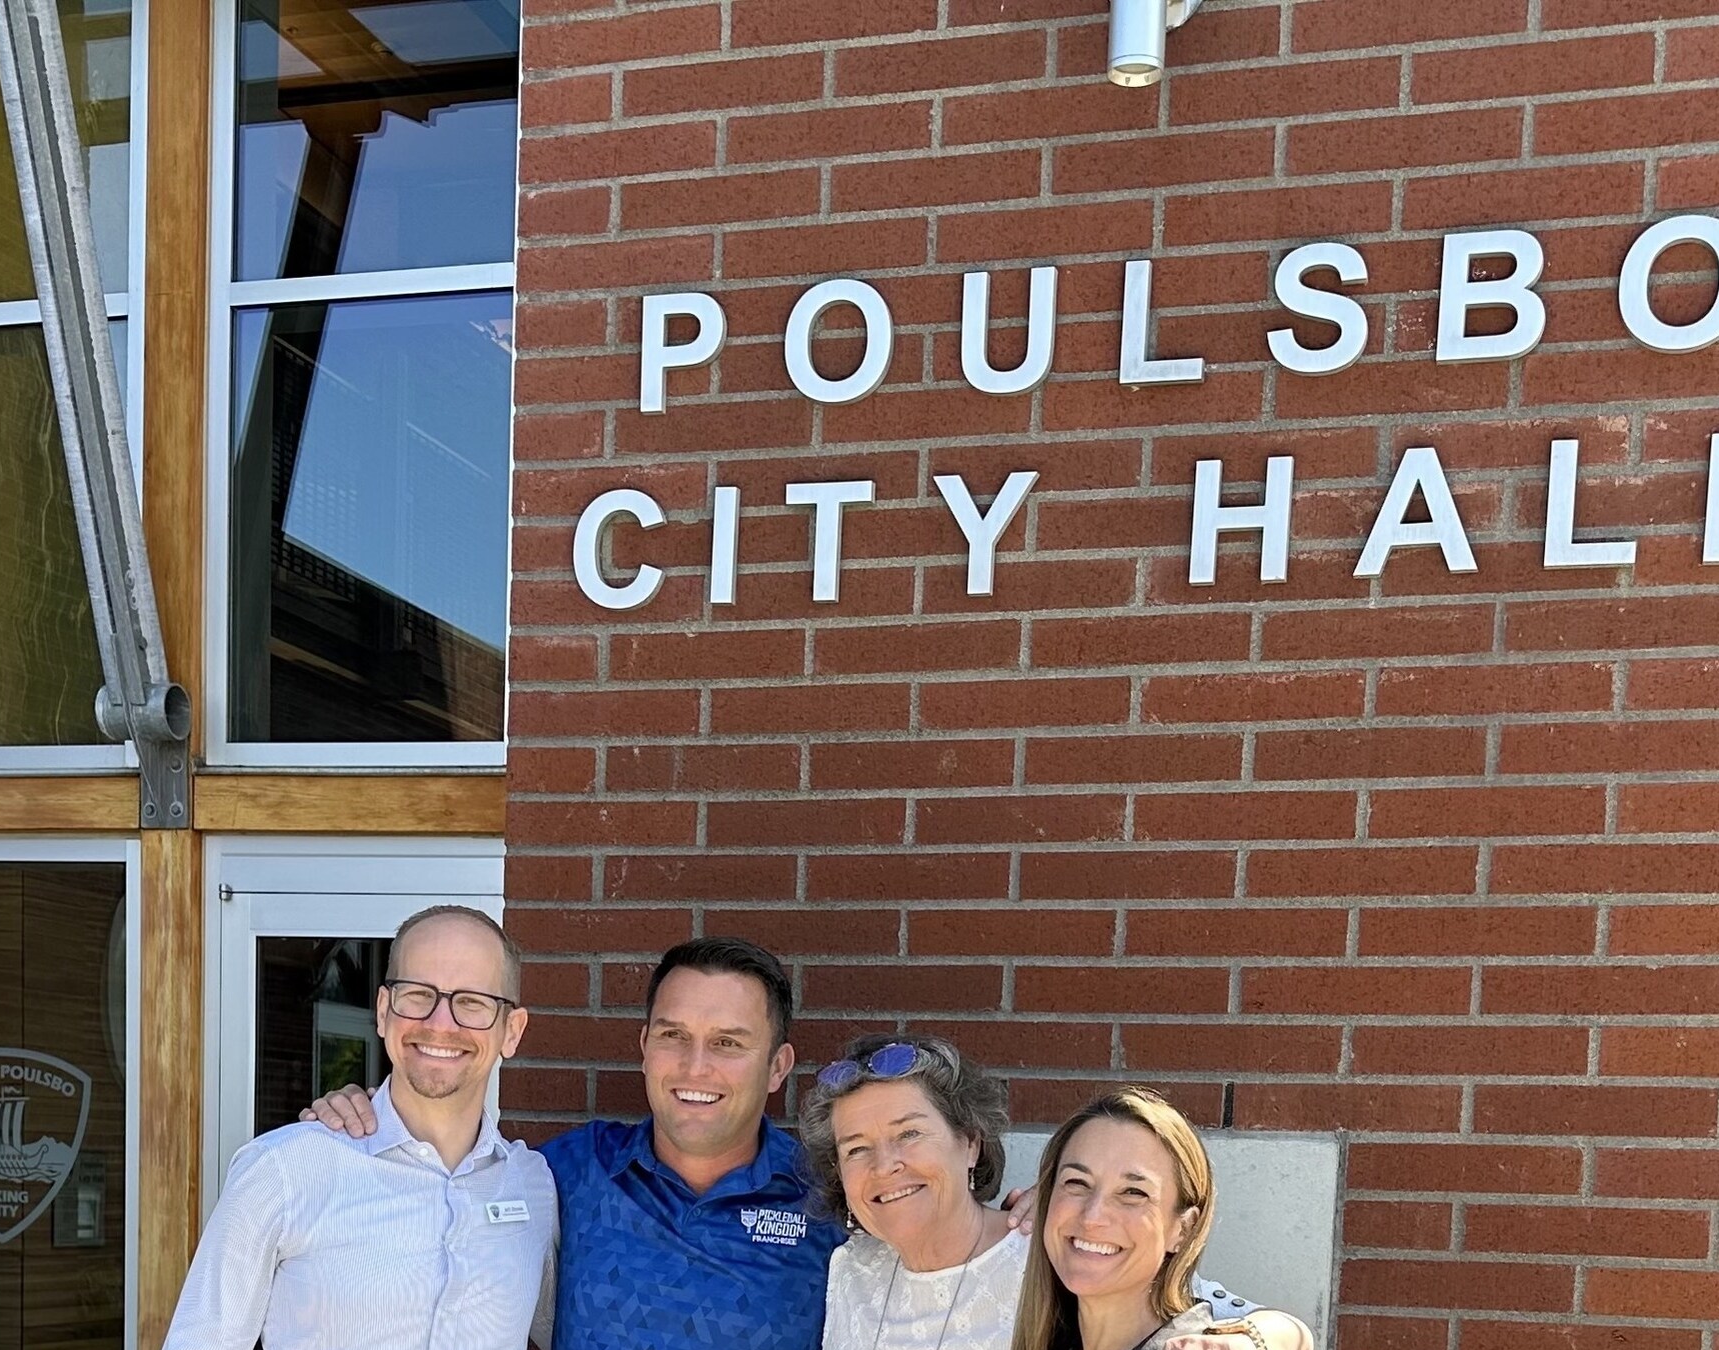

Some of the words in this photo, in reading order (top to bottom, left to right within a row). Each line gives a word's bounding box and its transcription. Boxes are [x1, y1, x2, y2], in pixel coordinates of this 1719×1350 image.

[572, 470, 1038, 610] CITY
[0, 1064, 76, 1097] POULSBO
[755, 1220, 807, 1238] KINGDOM
[758, 1209, 807, 1225] PICKLEBALL
